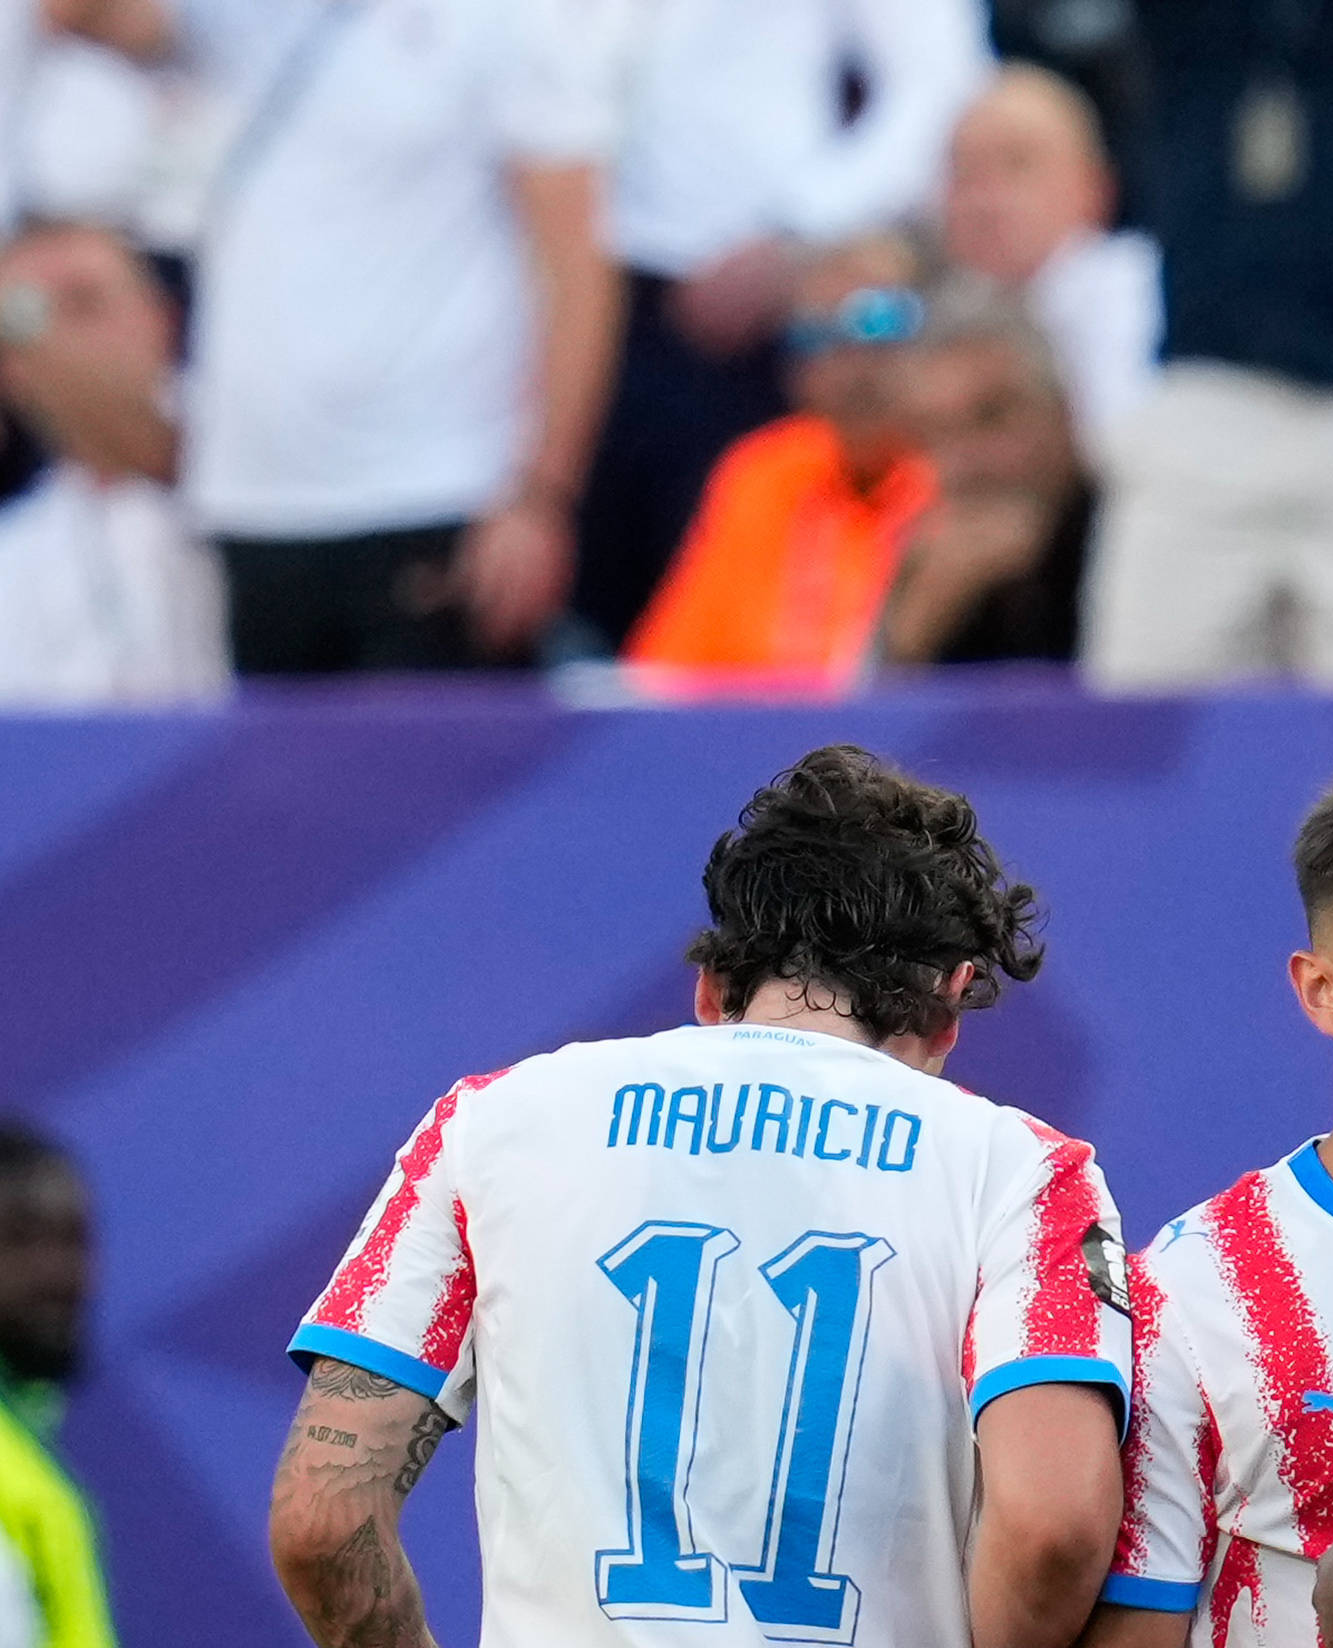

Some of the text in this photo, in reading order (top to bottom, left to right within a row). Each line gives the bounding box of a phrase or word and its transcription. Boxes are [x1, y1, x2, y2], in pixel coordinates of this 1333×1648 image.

[733, 1031, 816, 1047] PARAGUAY
[607, 1082, 922, 1172] MAURICIO
[594, 1220, 897, 1647] 11
